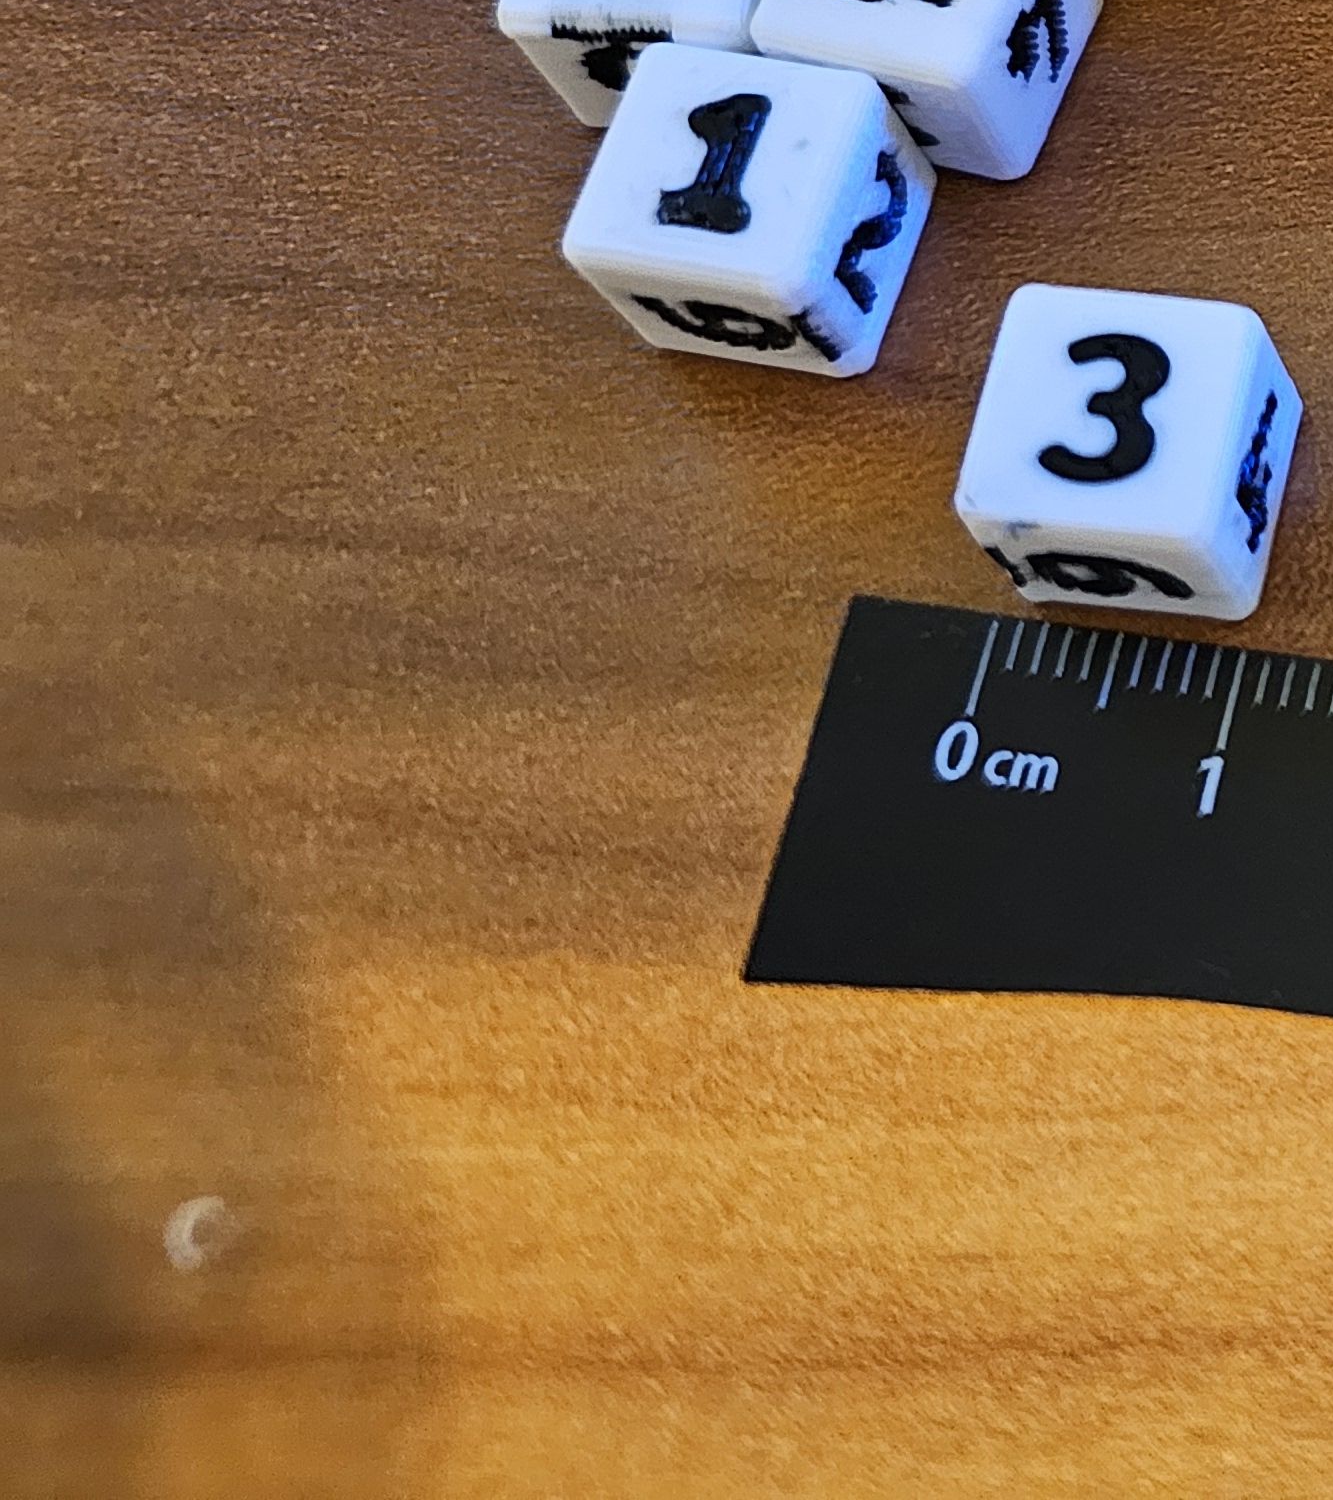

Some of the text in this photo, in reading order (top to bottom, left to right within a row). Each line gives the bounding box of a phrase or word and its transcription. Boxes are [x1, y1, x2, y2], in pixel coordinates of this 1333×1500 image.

[657, 94, 772, 235] 1
[1037, 333, 1170, 483] 3
[935, 720, 979, 782] 0
[983, 749, 1060, 794] cm
[1197, 756, 1226, 817] 1
